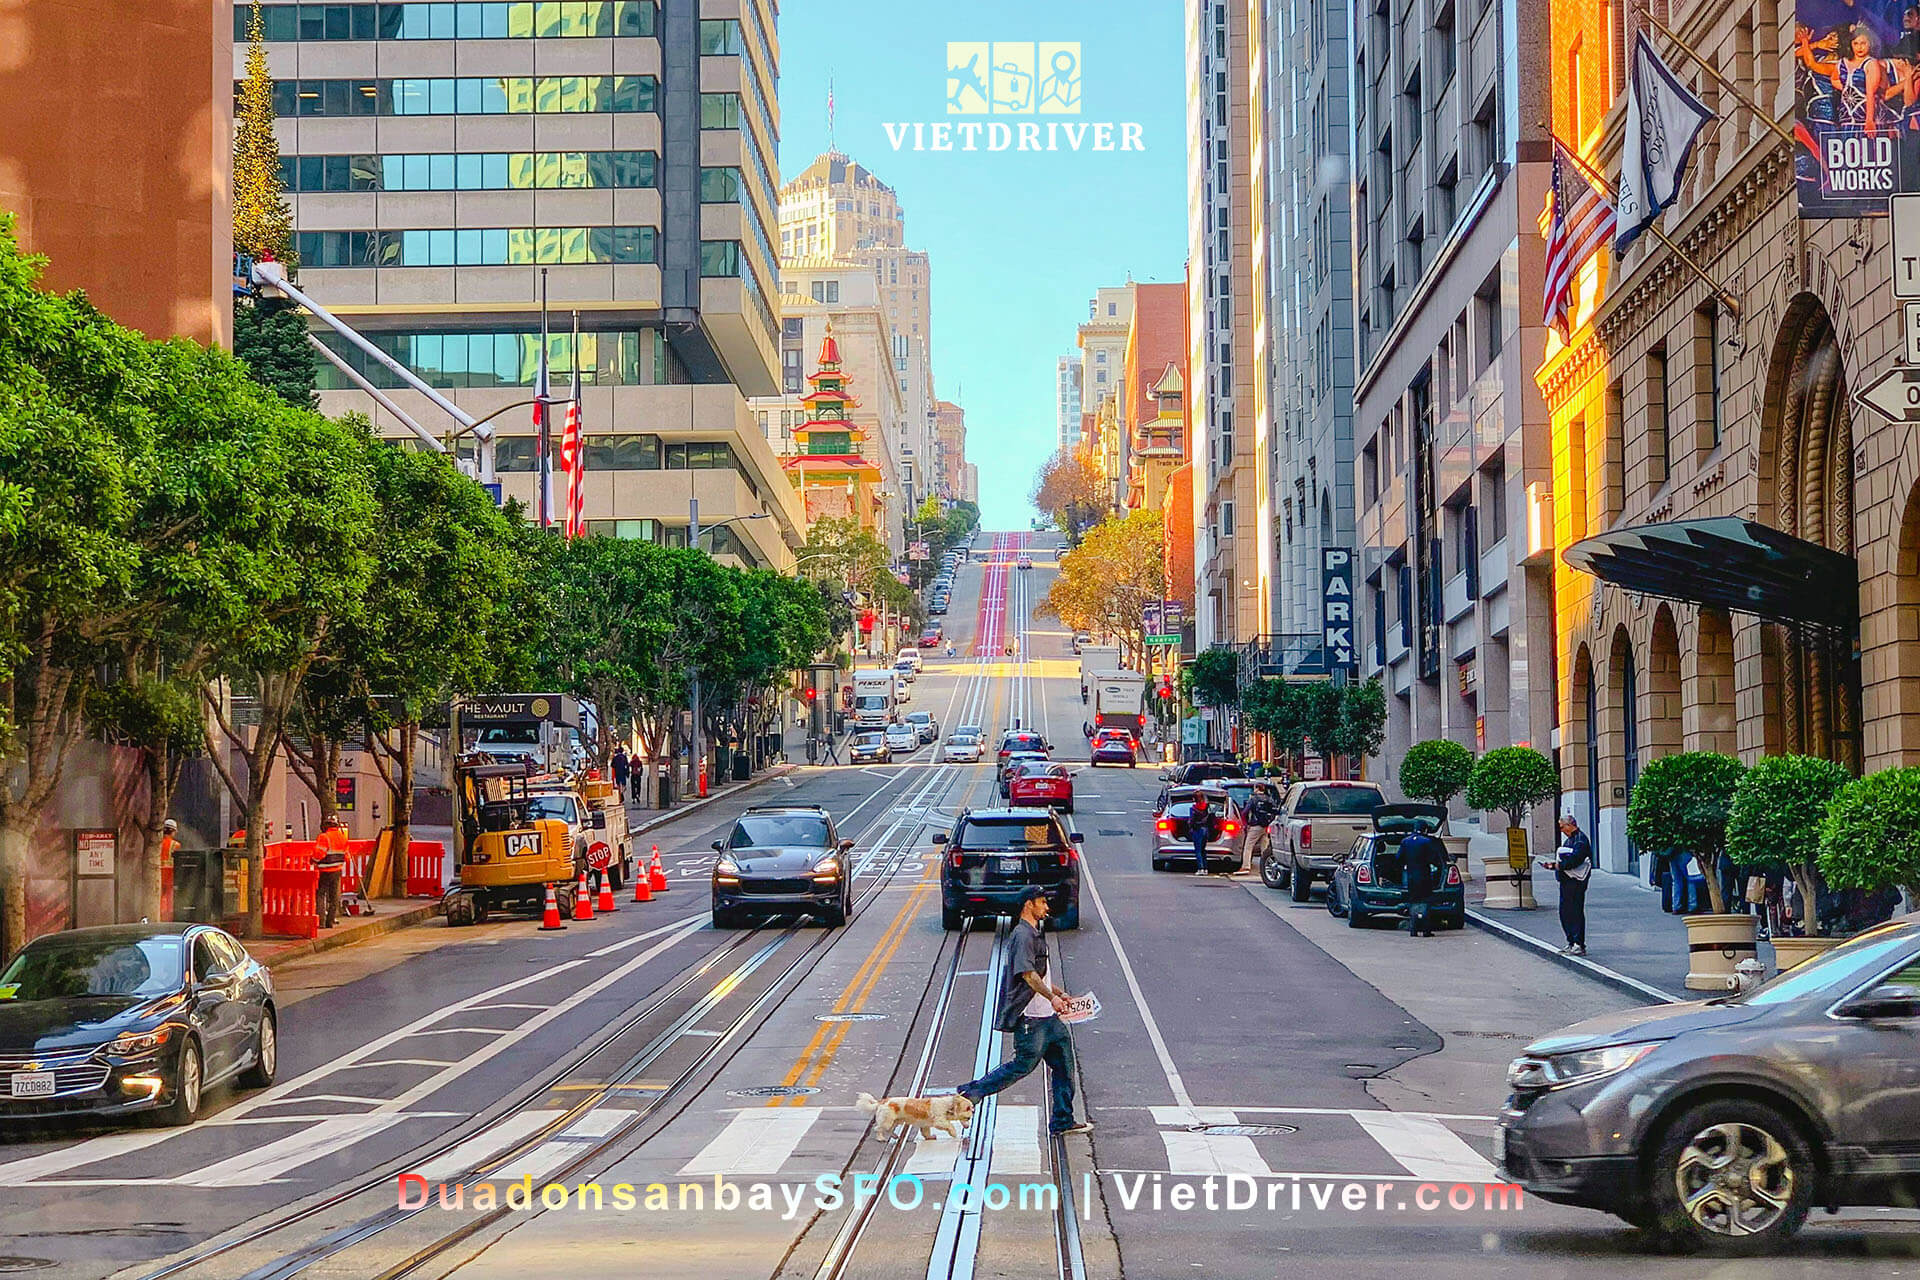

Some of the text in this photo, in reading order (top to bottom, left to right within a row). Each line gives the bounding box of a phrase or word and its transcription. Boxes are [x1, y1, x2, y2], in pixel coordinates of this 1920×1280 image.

[1827, 137, 1892, 168] BOLD
[1829, 168, 1893, 191] WORKS
[1325, 551, 1351, 647] PARK
[485, 703, 525, 713] VAULT
[508, 834, 539, 856] CAT
[588, 847, 609, 865] STOP
